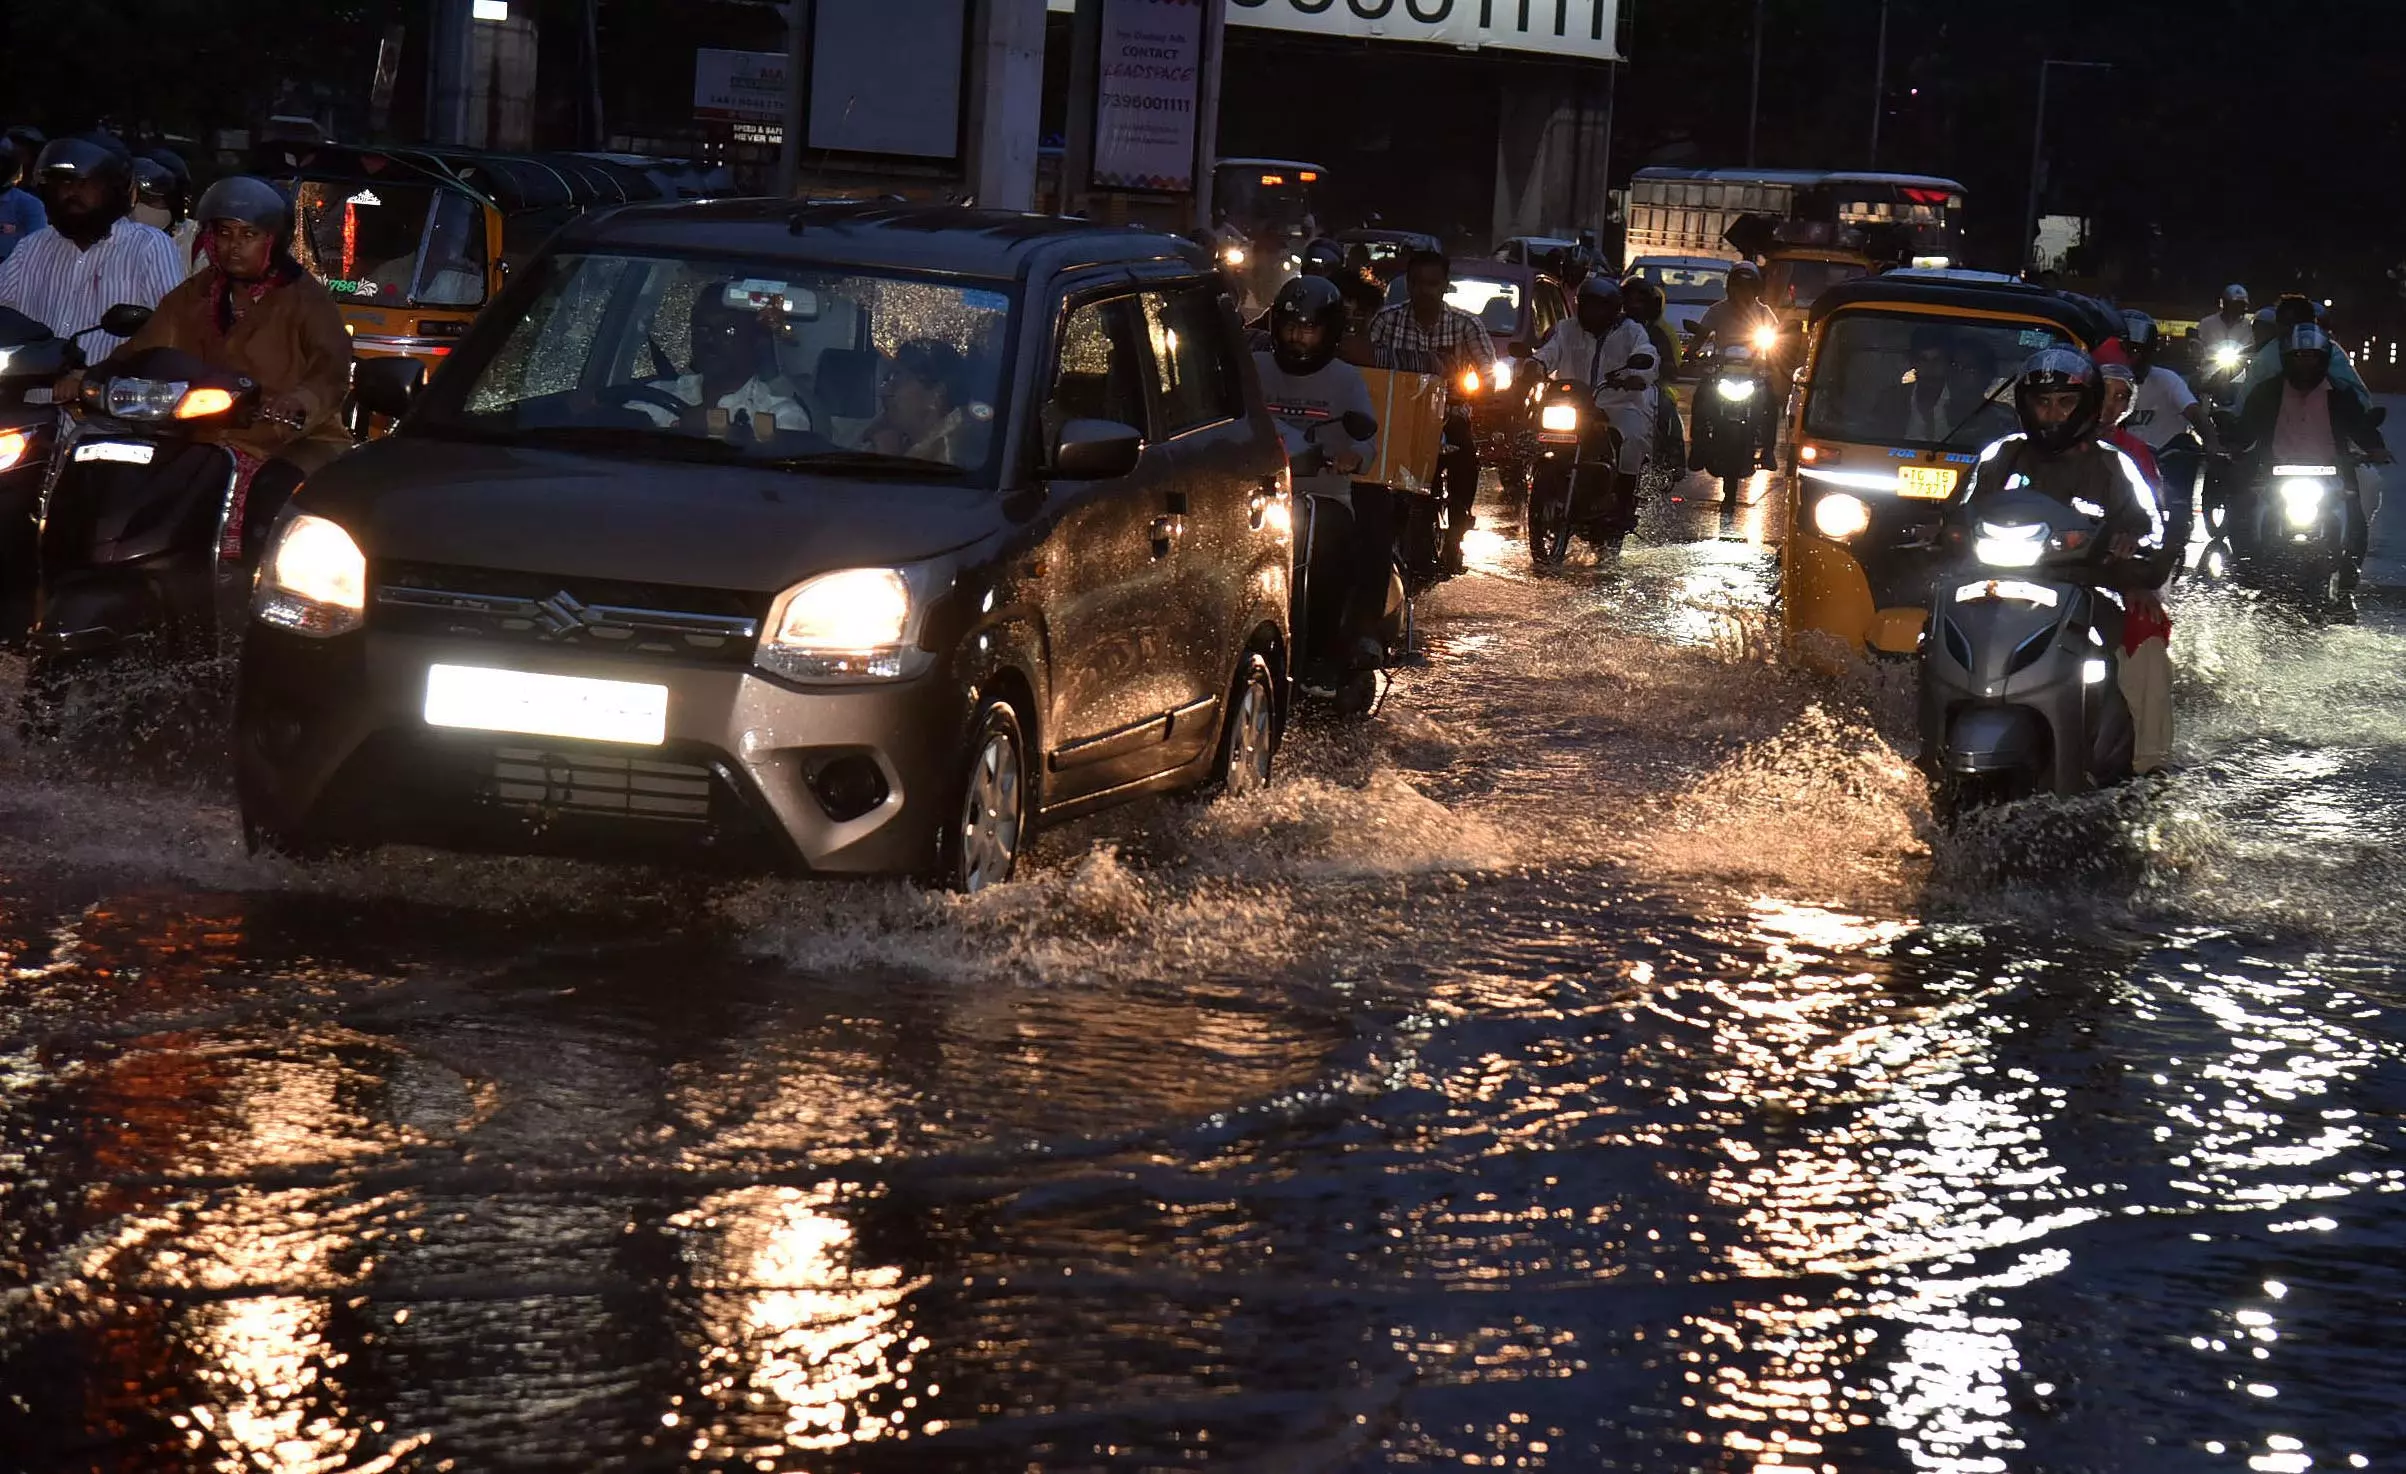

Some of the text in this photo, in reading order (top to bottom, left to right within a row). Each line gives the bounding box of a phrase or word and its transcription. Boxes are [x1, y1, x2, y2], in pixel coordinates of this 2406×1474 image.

[1122, 45, 1179, 60] CONTACT
[1104, 63, 1193, 83] LEADSPACE
[734, 133, 766, 142] NEVER
[328, 280, 358, 294] 786
[1888, 448, 1917, 459] FOR
